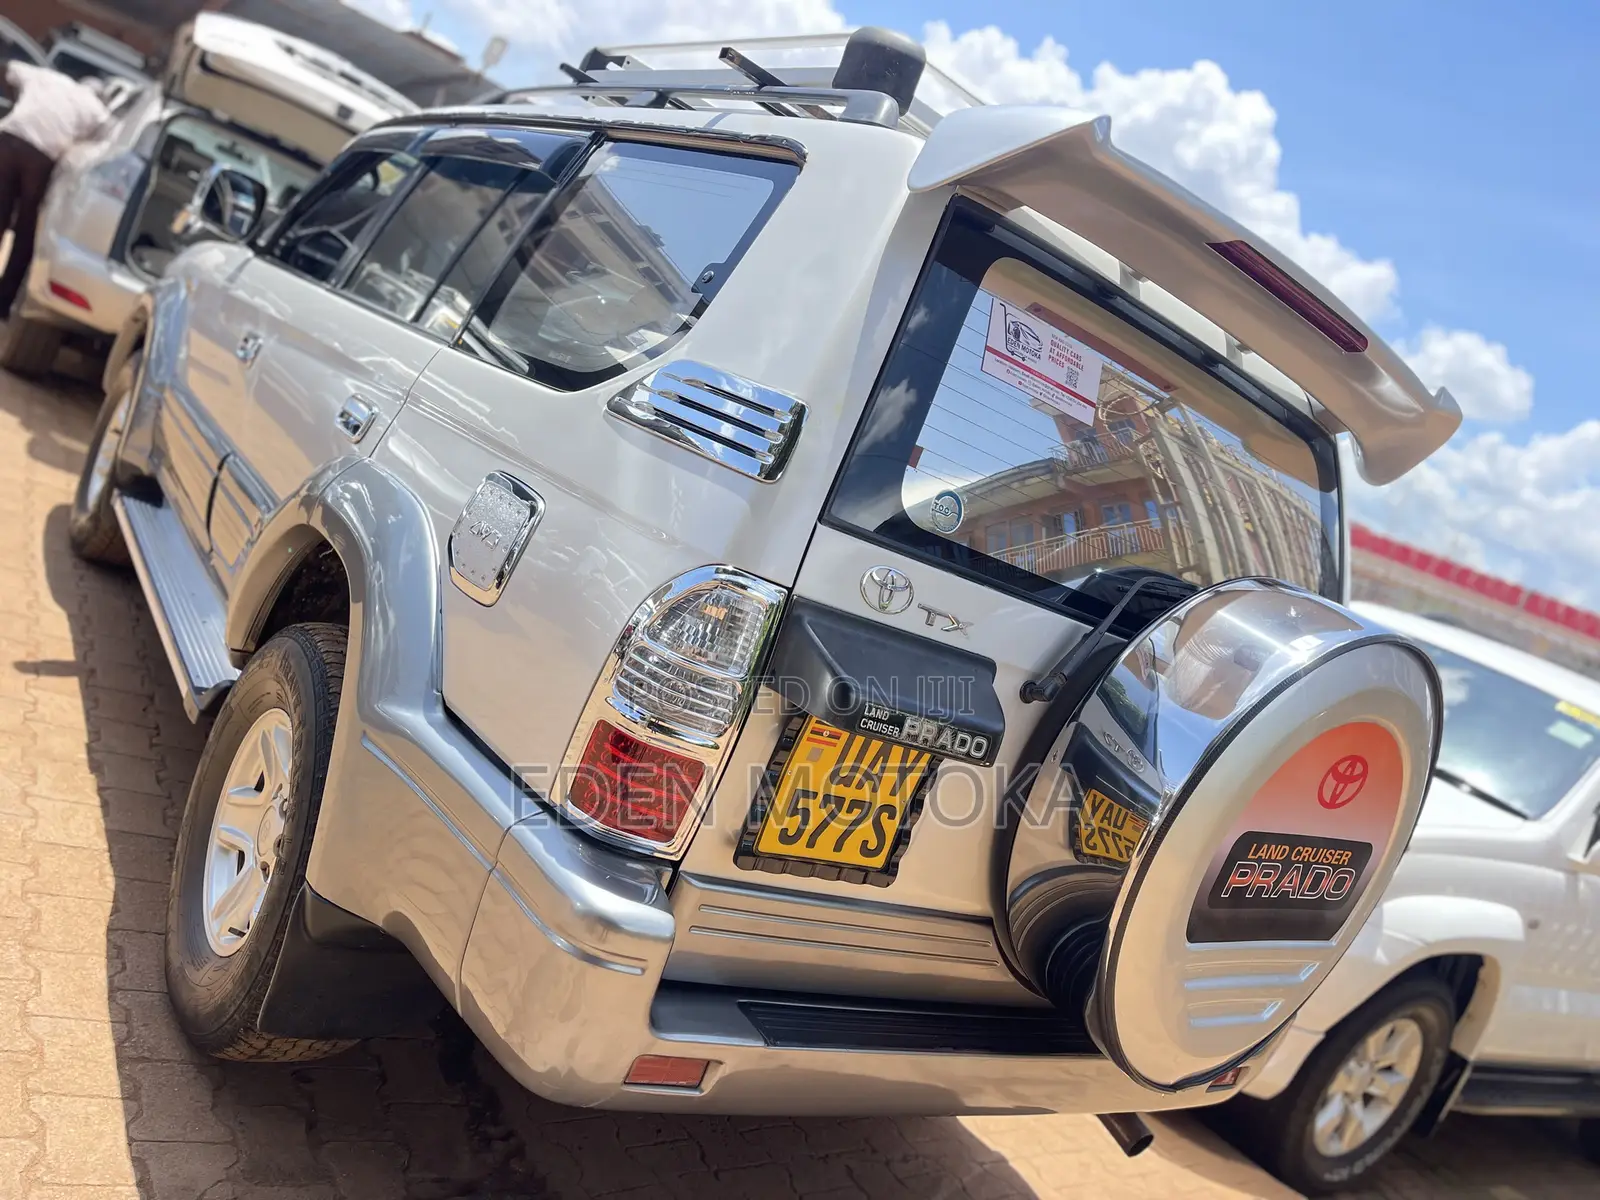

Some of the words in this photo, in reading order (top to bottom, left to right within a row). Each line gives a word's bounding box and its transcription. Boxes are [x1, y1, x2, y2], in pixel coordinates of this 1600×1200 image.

[917, 603, 974, 639] TX
[863, 702, 890, 721] LAND
[860, 718, 900, 738] CRUISER
[900, 716, 988, 758] PRADO
[777, 788, 897, 859] 577S
[1247, 843, 1290, 860] LAND
[1290, 846, 1353, 866] CRUISER
[1220, 861, 1356, 901] PRADO
